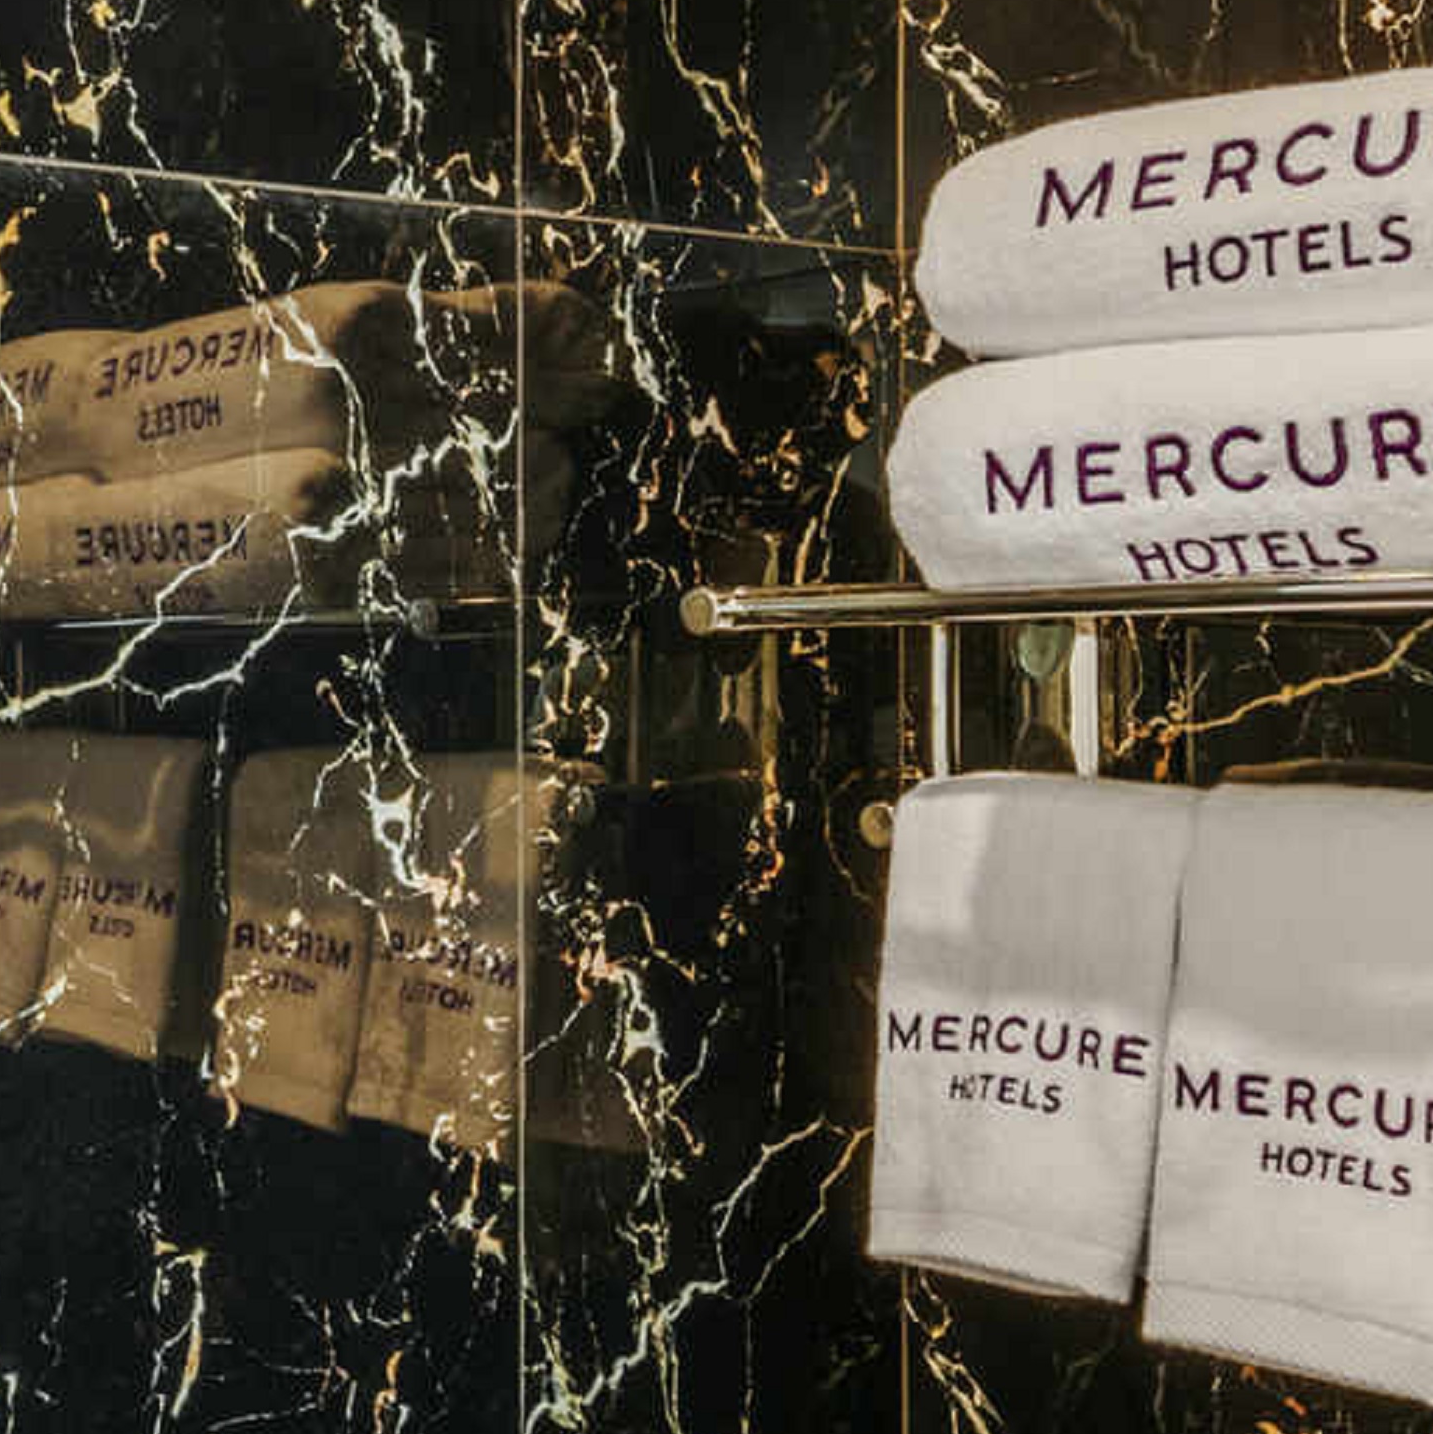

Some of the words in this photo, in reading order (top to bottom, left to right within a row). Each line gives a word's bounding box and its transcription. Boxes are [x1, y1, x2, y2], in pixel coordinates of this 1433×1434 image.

[1161, 212, 1414, 291] HOTELS
[1126, 527, 1381, 582] HOTELS
[887, 1011, 1151, 1078] MERCURE
[948, 1073, 1063, 1114] HOTELS
[1259, 1139, 1414, 1198] HOTELS
